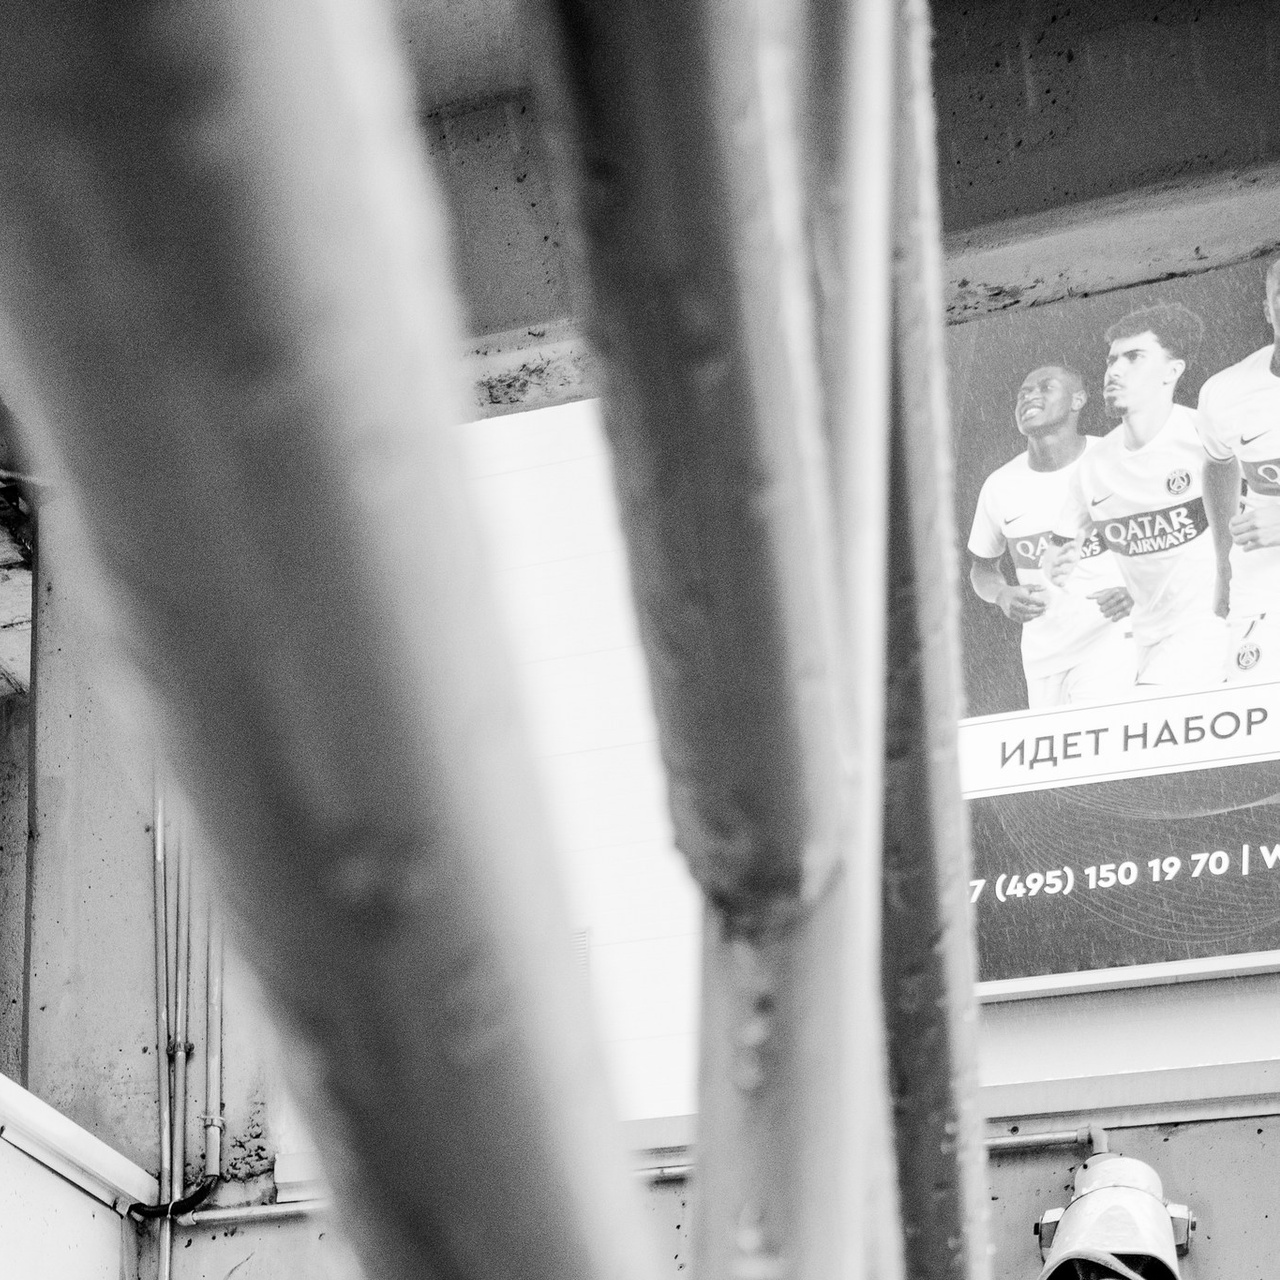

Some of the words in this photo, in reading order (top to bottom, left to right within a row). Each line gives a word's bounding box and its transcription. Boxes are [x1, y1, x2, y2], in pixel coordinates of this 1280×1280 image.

[1104, 507, 1194, 545] QATAR
[1128, 523, 1198, 555] AIRWAYS
[1001, 727, 1109, 770] ИДЕТ
[1123, 707, 1268, 752] НАБОР
[995, 866, 1074, 902] (495)
[1084, 861, 1138, 889] 150
[1148, 856, 1182, 881] 19
[1191, 851, 1230, 877] 70
